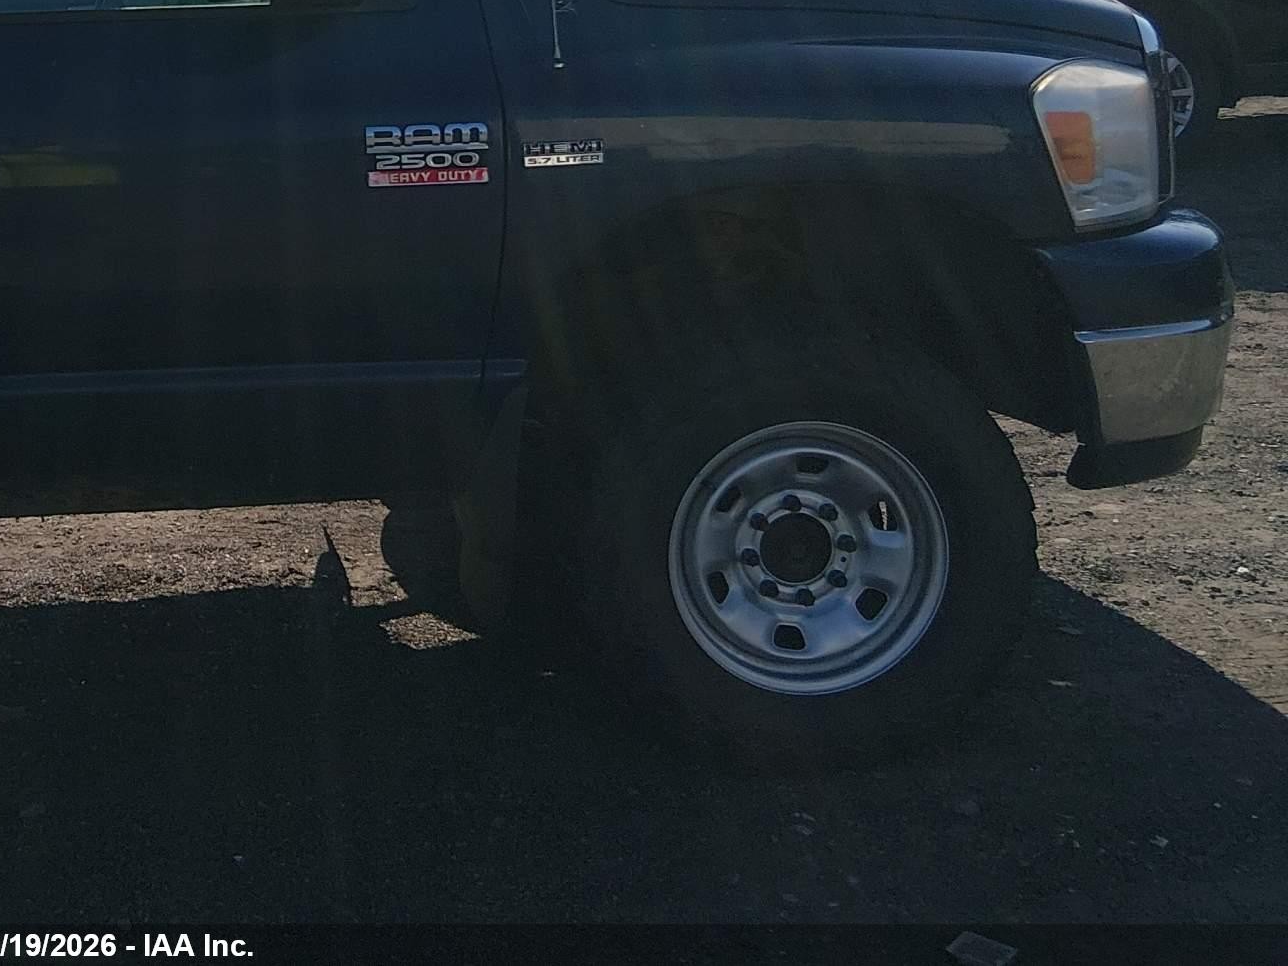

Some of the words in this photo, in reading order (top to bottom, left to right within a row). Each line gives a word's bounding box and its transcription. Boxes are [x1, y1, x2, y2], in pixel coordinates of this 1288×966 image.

[365, 122, 488, 146] RAM
[524, 139, 602, 155] HEMI
[375, 151, 480, 170] 2500
[527, 156, 552, 165] 5.7
[556, 154, 600, 164] LITER
[383, 171, 431, 184] EAVY
[438, 168, 477, 182] DUTY
